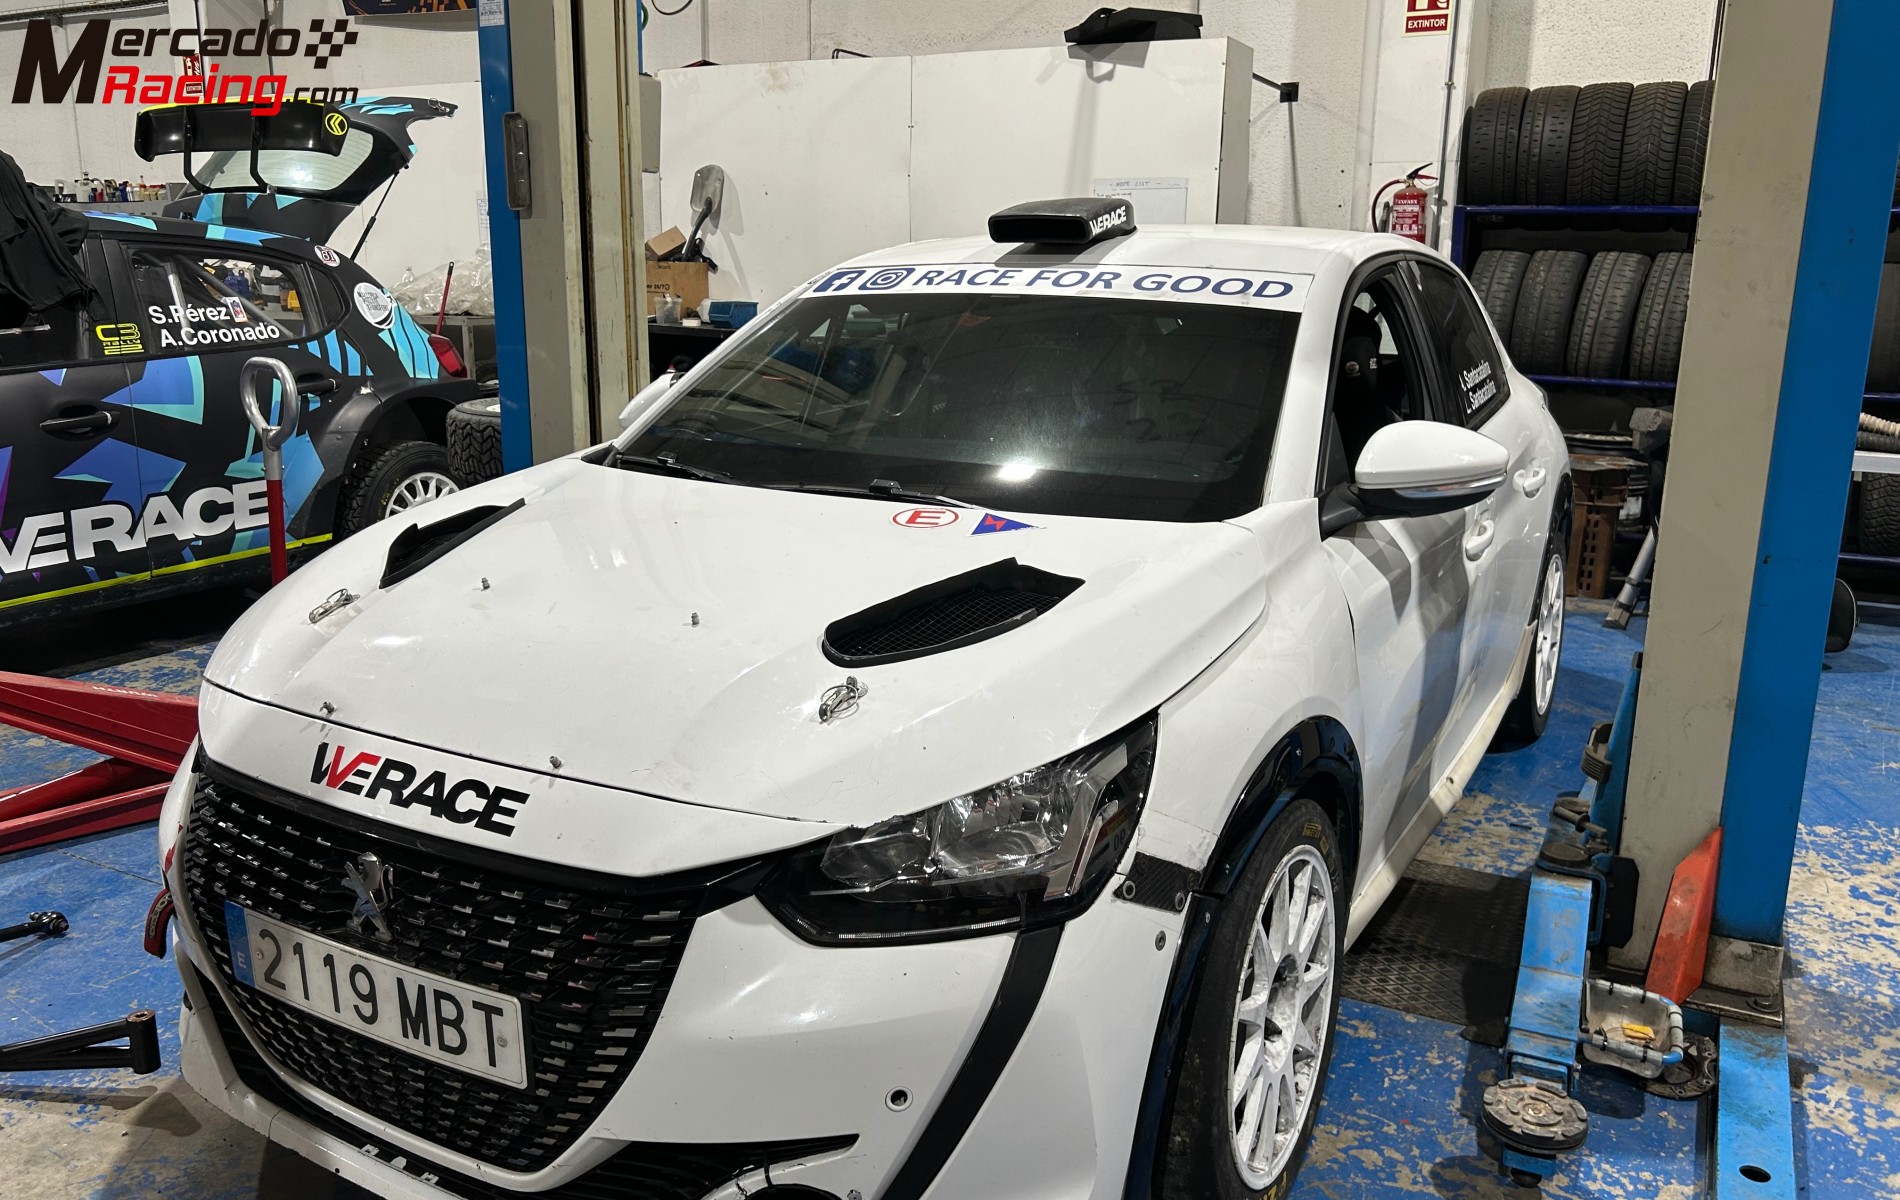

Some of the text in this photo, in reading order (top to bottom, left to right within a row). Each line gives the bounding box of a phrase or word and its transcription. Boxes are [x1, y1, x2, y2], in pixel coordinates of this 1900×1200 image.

[1407, 18, 1446, 29] EXTINTOR
[1089, 205, 1127, 236] WERACE
[912, 269, 1021, 288] RACE
[1026, 270, 1125, 290] FOR
[1133, 272, 1294, 298] GOOD
[148, 303, 231, 325] S.Pérez
[95, 323, 141, 342] C3
[160, 321, 280, 348] A.Coronado
[905, 510, 947, 526] E
[310, 742, 531, 838] WERACE
[238, 928, 504, 1068] E 2119 MBT
